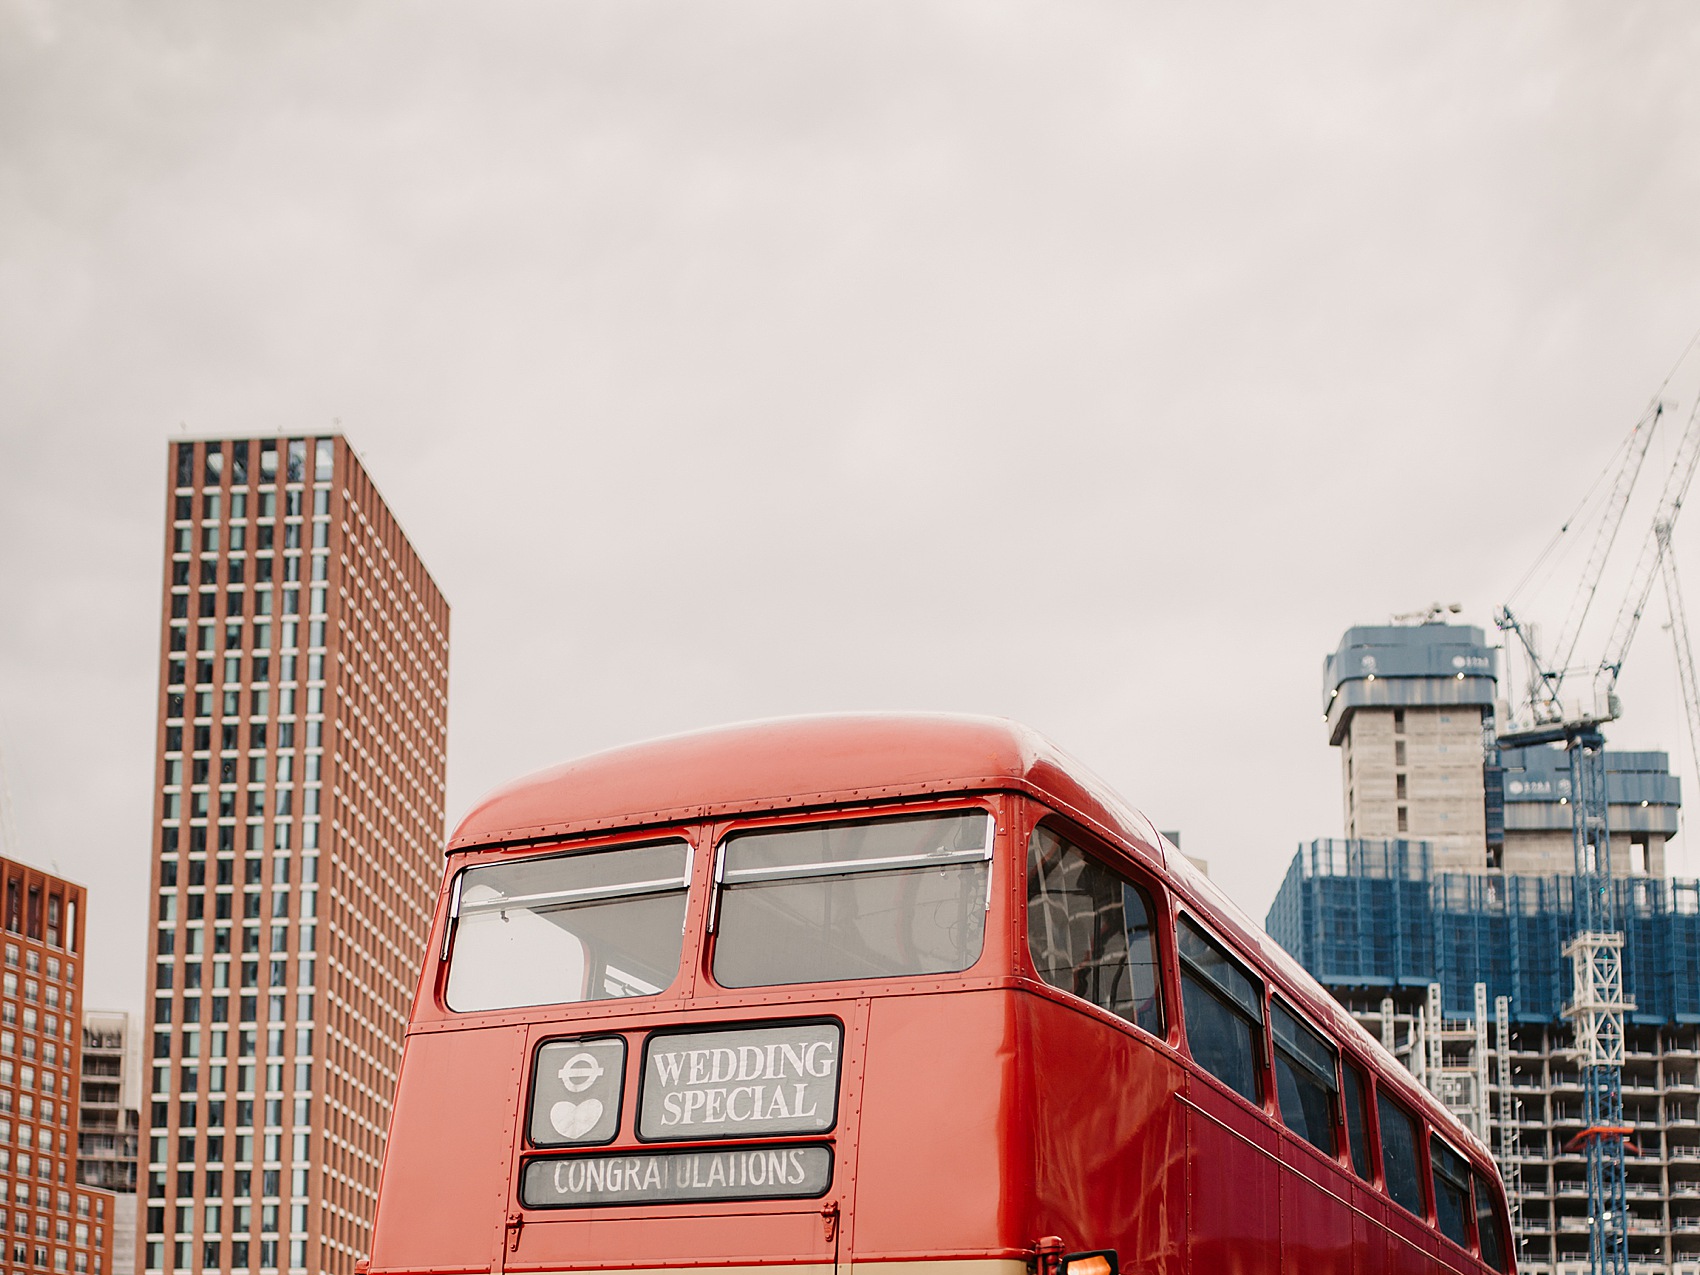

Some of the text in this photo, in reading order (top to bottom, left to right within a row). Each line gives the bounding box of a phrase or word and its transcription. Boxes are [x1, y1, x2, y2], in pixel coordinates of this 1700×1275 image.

[653, 1041, 834, 1087] WEDDING
[661, 1083, 817, 1125] SPECIAL
[554, 1150, 806, 1194] CONGRAULATIONS
